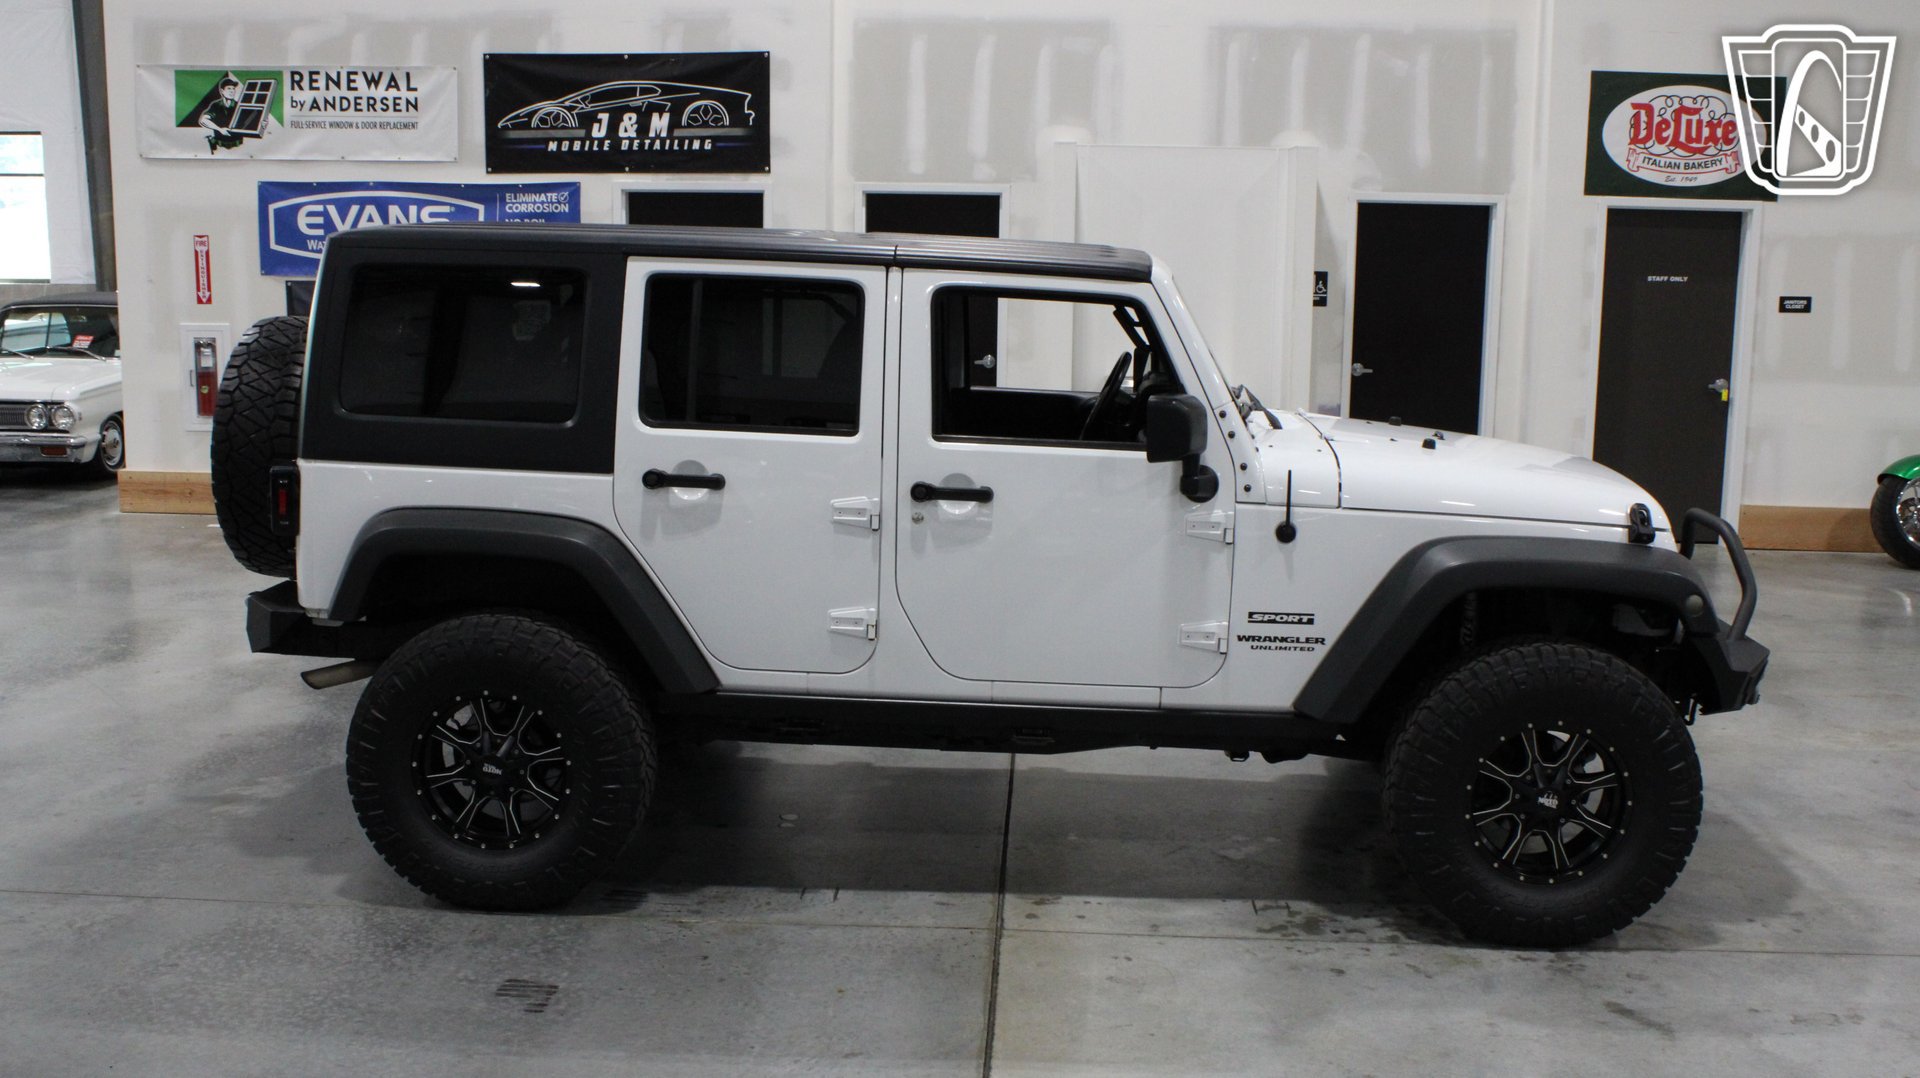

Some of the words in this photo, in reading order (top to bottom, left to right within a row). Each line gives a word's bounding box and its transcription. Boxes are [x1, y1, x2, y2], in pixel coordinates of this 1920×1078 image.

[290, 70, 418, 92] RENEWAL
[290, 96, 306, 112] by
[309, 96, 418, 112] ANDERSEN
[328, 121, 354, 130] WINDOW
[355, 122, 360, 130] &
[361, 122, 377, 130] DOOR
[379, 121, 418, 130] REPLACEMENT
[591, 112, 610, 138] J
[618, 112, 637, 138] &
[649, 112, 670, 138] M
[1627, 102, 1738, 154] DeLuxe
[548, 140, 611, 152] MOBILE
[621, 138, 713, 151] DETAILING
[1642, 156, 1681, 170] ITALIAN
[1684, 157, 1724, 171] BAKERY
[506, 192, 558, 202] ELIMINATE
[506, 203, 569, 213] CORROSION
[1248, 613, 1314, 623] SPORT
[1236, 634, 1326, 645] WRANGLER
